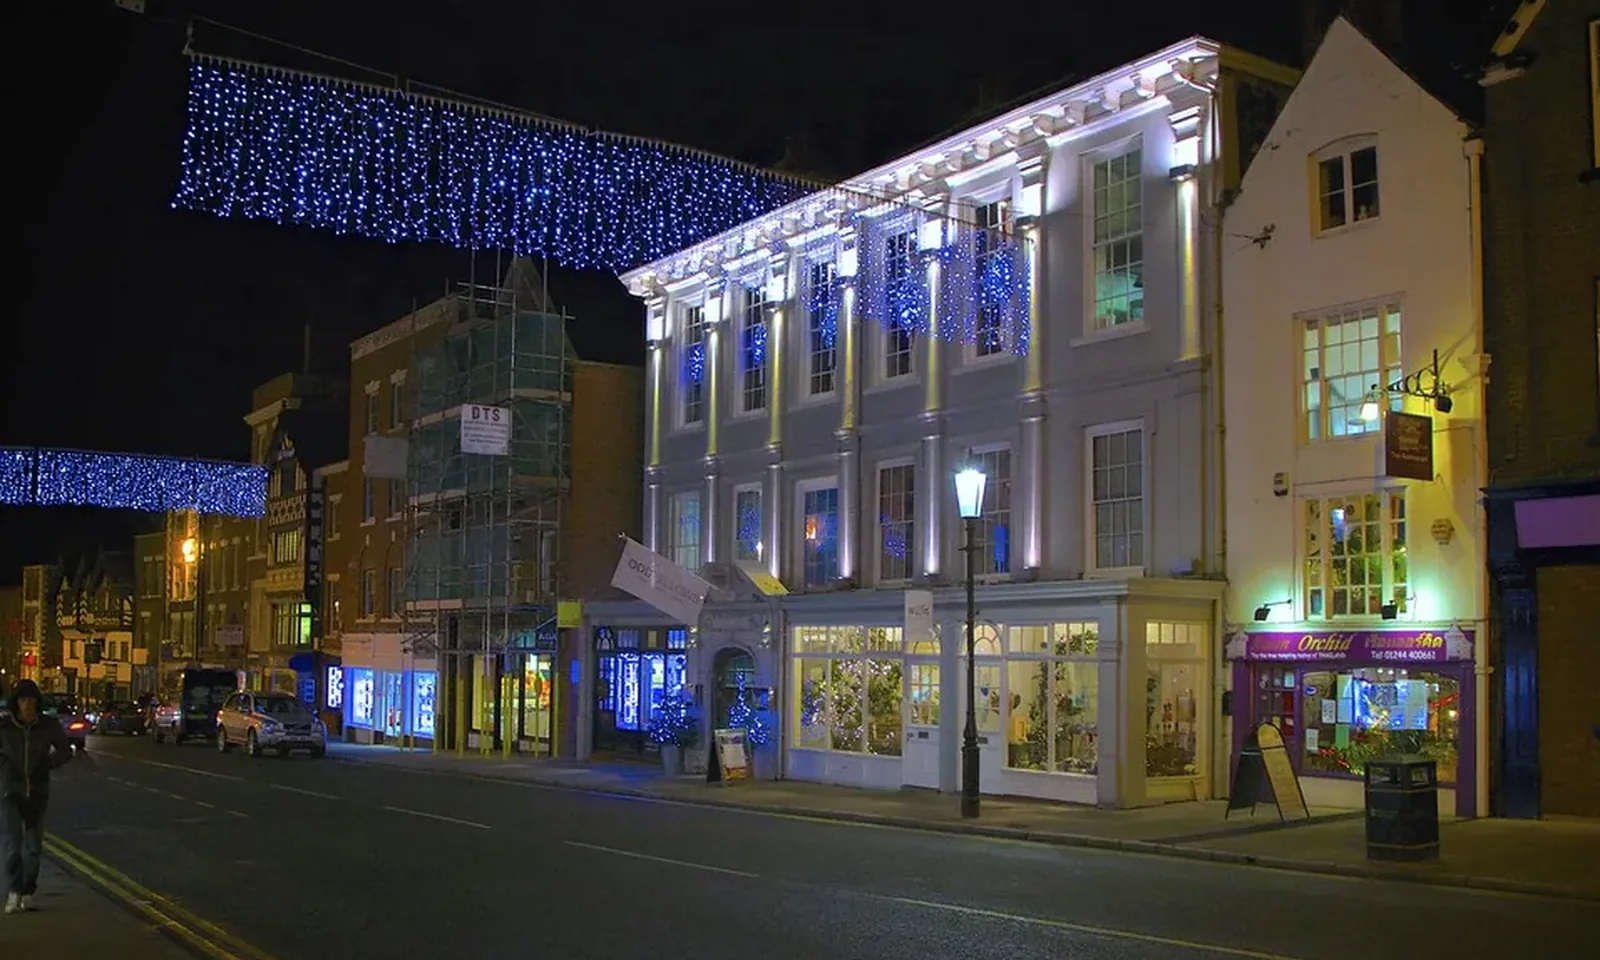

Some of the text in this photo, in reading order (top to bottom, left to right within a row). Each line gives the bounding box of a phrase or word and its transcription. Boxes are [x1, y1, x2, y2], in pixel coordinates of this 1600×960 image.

[471, 406, 500, 422] DTS
[1299, 633, 1356, 651] Orchid
[1384, 650, 1407, 659] 01244
